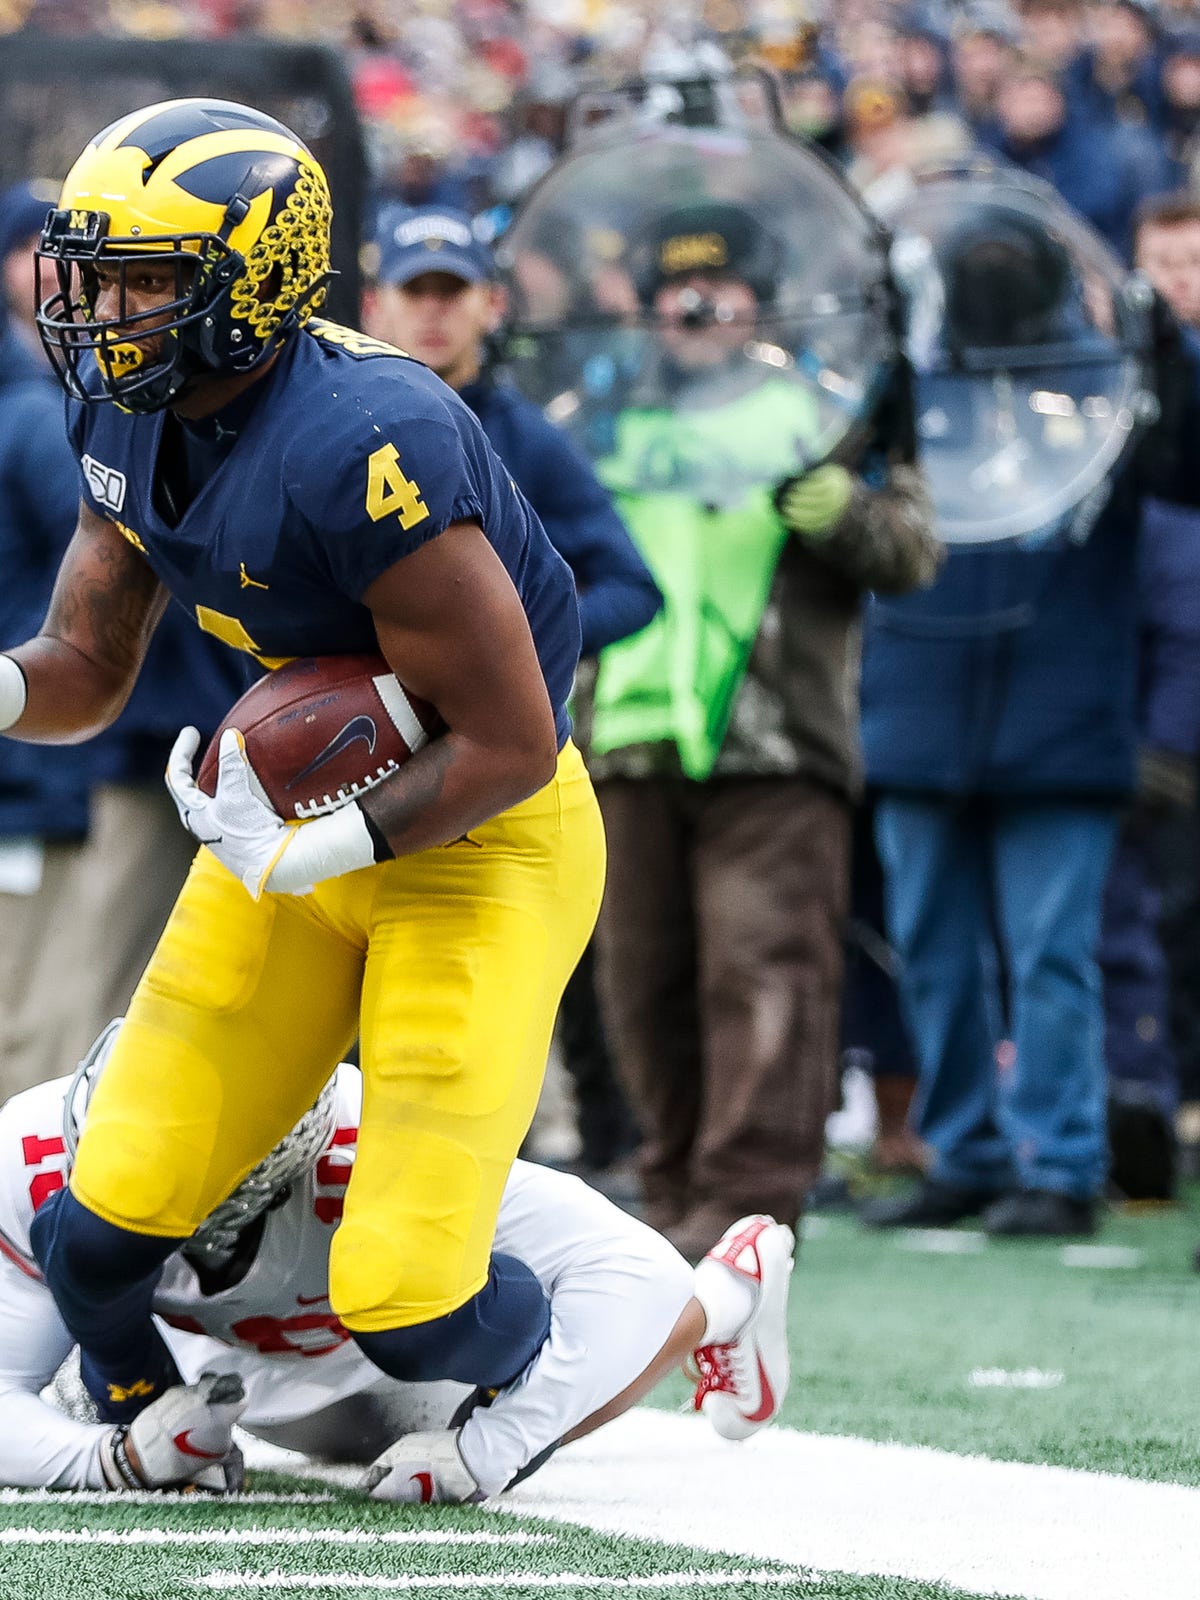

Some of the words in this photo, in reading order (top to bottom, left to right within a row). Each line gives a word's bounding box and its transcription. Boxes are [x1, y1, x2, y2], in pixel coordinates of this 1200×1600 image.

[69, 210, 88, 229] M
[119, 351, 137, 365] M
[366, 442, 430, 531] 4
